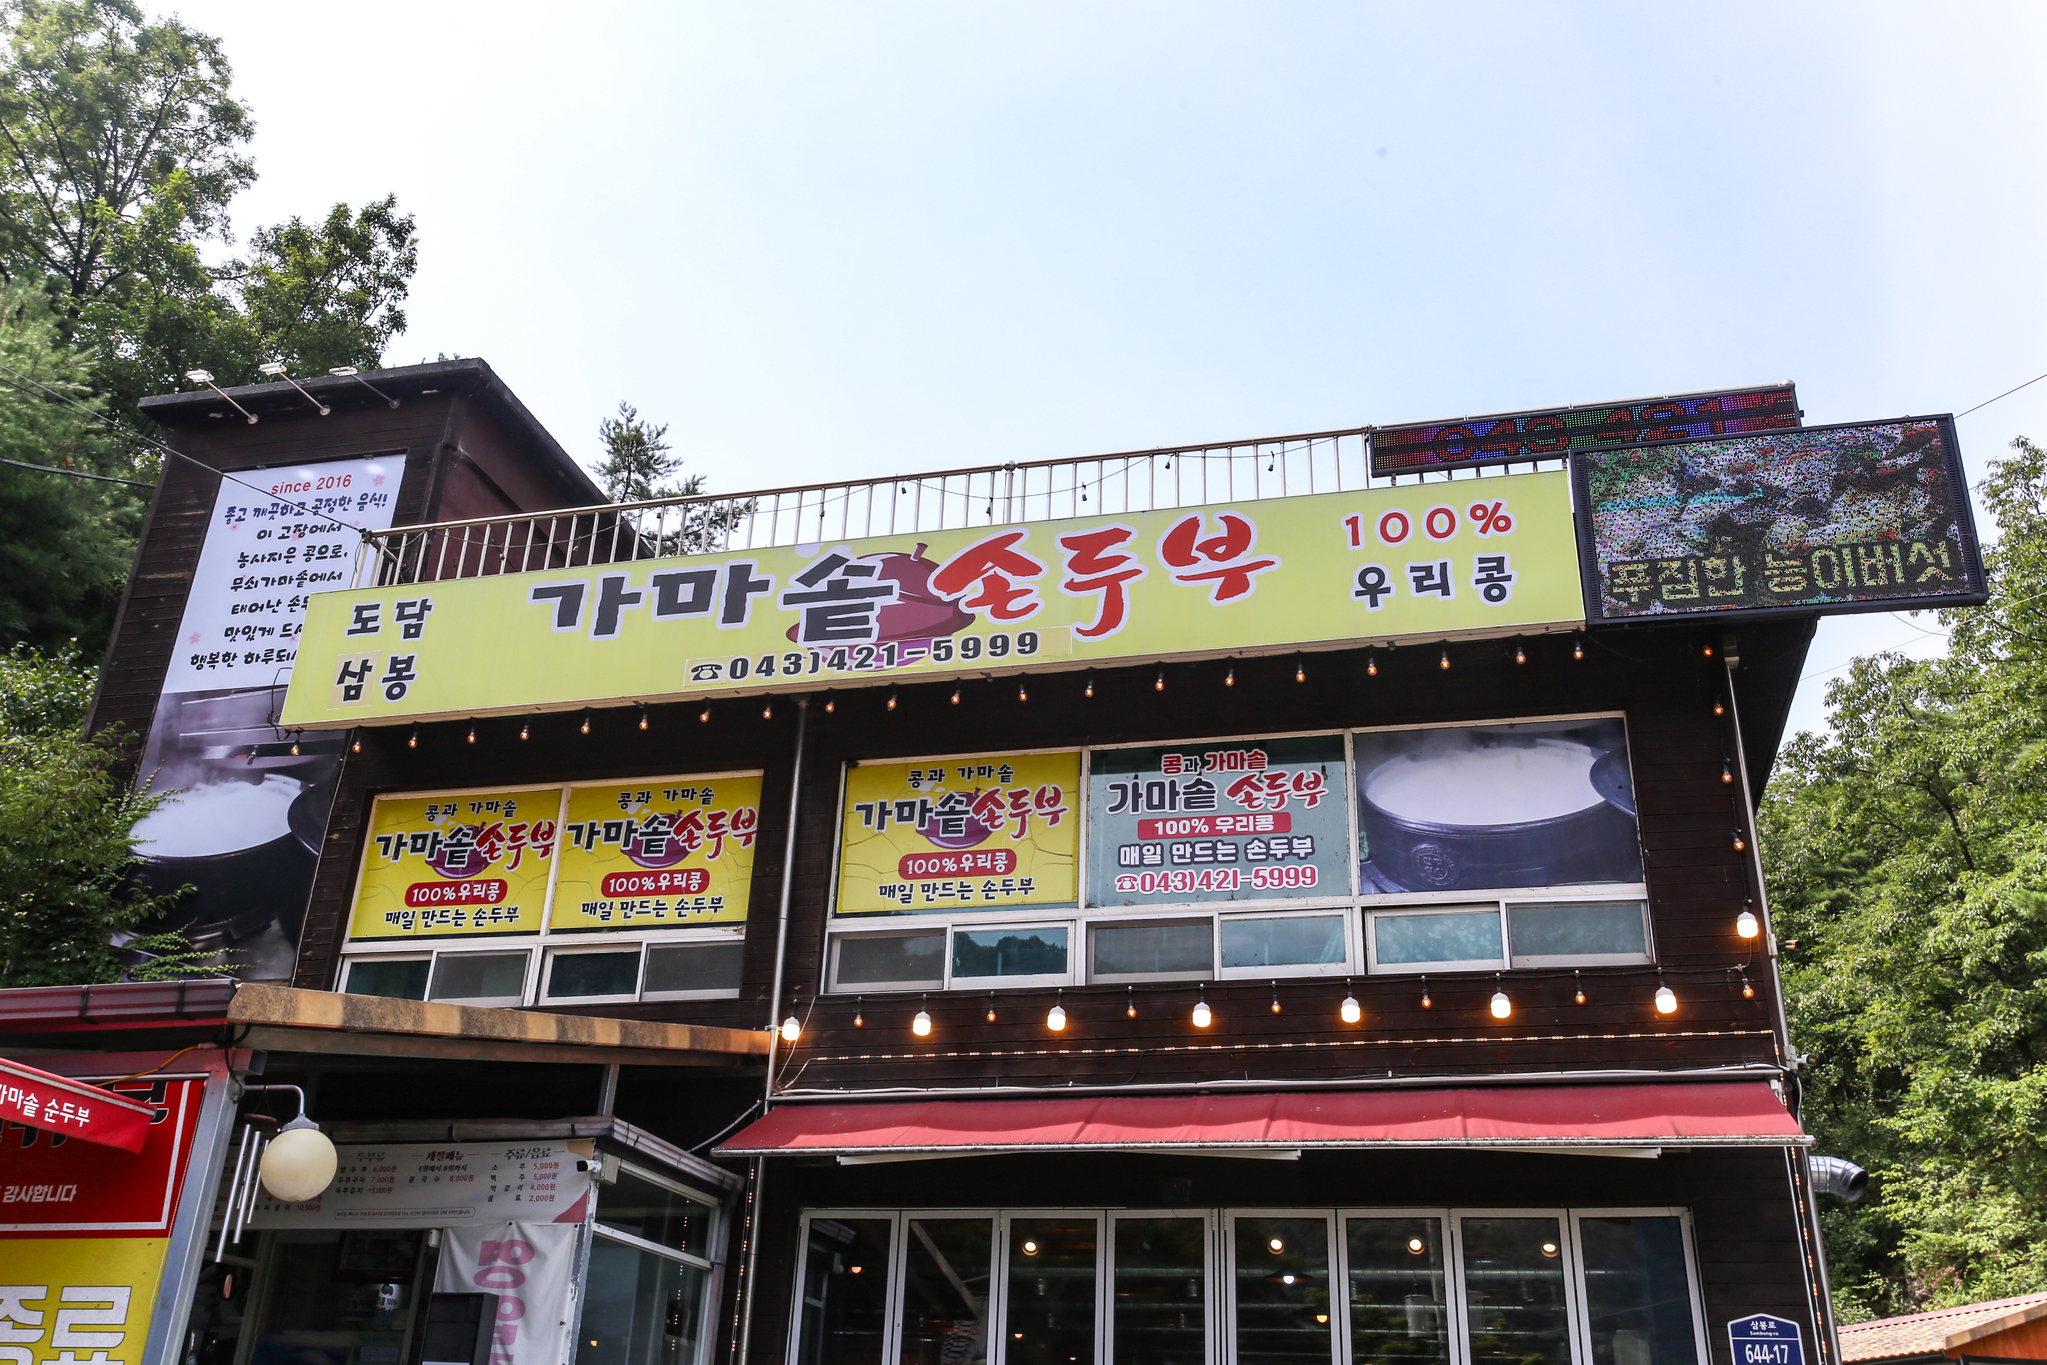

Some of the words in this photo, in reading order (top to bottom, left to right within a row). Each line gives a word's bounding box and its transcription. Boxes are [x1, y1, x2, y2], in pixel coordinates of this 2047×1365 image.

[271, 481, 311, 494] since
[316, 475, 352, 490] 2016
[252, 502, 306, 520] 깨끗하고
[312, 496, 352, 515] 공정한
[357, 493, 388, 511] 음식!
[257, 529, 272, 540] 이
[278, 523, 342, 540] 고장에서
[1345, 502, 1512, 546] 100%
[237, 547, 296, 569] 농사지은
[303, 544, 348, 563] 콩으로,
[231, 570, 342, 592] 무쇠가마솥에서
[532, 553, 894, 643] 가마솥
[933, 515, 1276, 638] 손두부
[1355, 556, 1512, 608] 우리콩
[231, 599, 282, 615] 태어난
[347, 599, 433, 639] 도담
[224, 625, 274, 642] 맛있게
[191, 651, 238, 670] 행복한
[729, 632, 1039, 680] 043)421-5999
[337, 655, 416, 701] 삼봉
[1162, 754, 1200, 775] 콩과
[1206, 750, 1267, 772] 가마솥
[908, 768, 945, 788] 콩과
[957, 763, 1014, 783] 가마솥
[616, 790, 652, 810] 콩과
[663, 787, 715, 805] 가마솥
[1107, 778, 1218, 813] 가마솥
[1226, 771, 1328, 809] 손두부
[425, 803, 459, 822] 콩과
[469, 800, 518, 818] 가마솥
[855, 792, 971, 836] 가마솥
[971, 786, 1068, 839] 손두부
[567, 814, 672, 857] 가마솥
[672, 808, 758, 860] 손두부
[1154, 818, 1209, 835] 100%
[1215, 814, 1275, 834] 우리콩
[376, 826, 475, 867] 가마솥
[475, 820, 555, 872] 손두부
[1120, 844, 1162, 866] 매일
[1172, 842, 1237, 863] 만드는
[1247, 838, 1313, 860] 손두부
[879, 883, 914, 904] 매일
[920, 880, 974, 902] 만드는
[981, 877, 1036, 900] 손두부
[1140, 866, 1317, 893] 043)421-5999
[385, 911, 416, 929] 매일
[421, 909, 467, 928] 만드는
[472, 906, 520, 926] 손두부
[582, 901, 613, 921] 매일
[619, 900, 668, 918] 만드는
[674, 896, 725, 917] 손두부
[44, 1098, 90, 1128] 순두부
[504, 1147, 552, 1160] 주류/음료
[372, 1165, 397, 1174] 6,000원
[533, 1162, 560, 1170] 5,000원
[533, 1172, 558, 1181] 5,000원
[368, 1187, 393, 1195] 15,000원
[371, 1176, 395, 1184] 7,000원
[530, 1183, 556, 1191] 4,000원
[4, 1184, 77, 1203] 감사합니다
[529, 1194, 555, 1203] 2,000원
[1750, 1320, 1777, 1330] 삼봉로
[1745, 1344, 1789, 1364] 644-17
